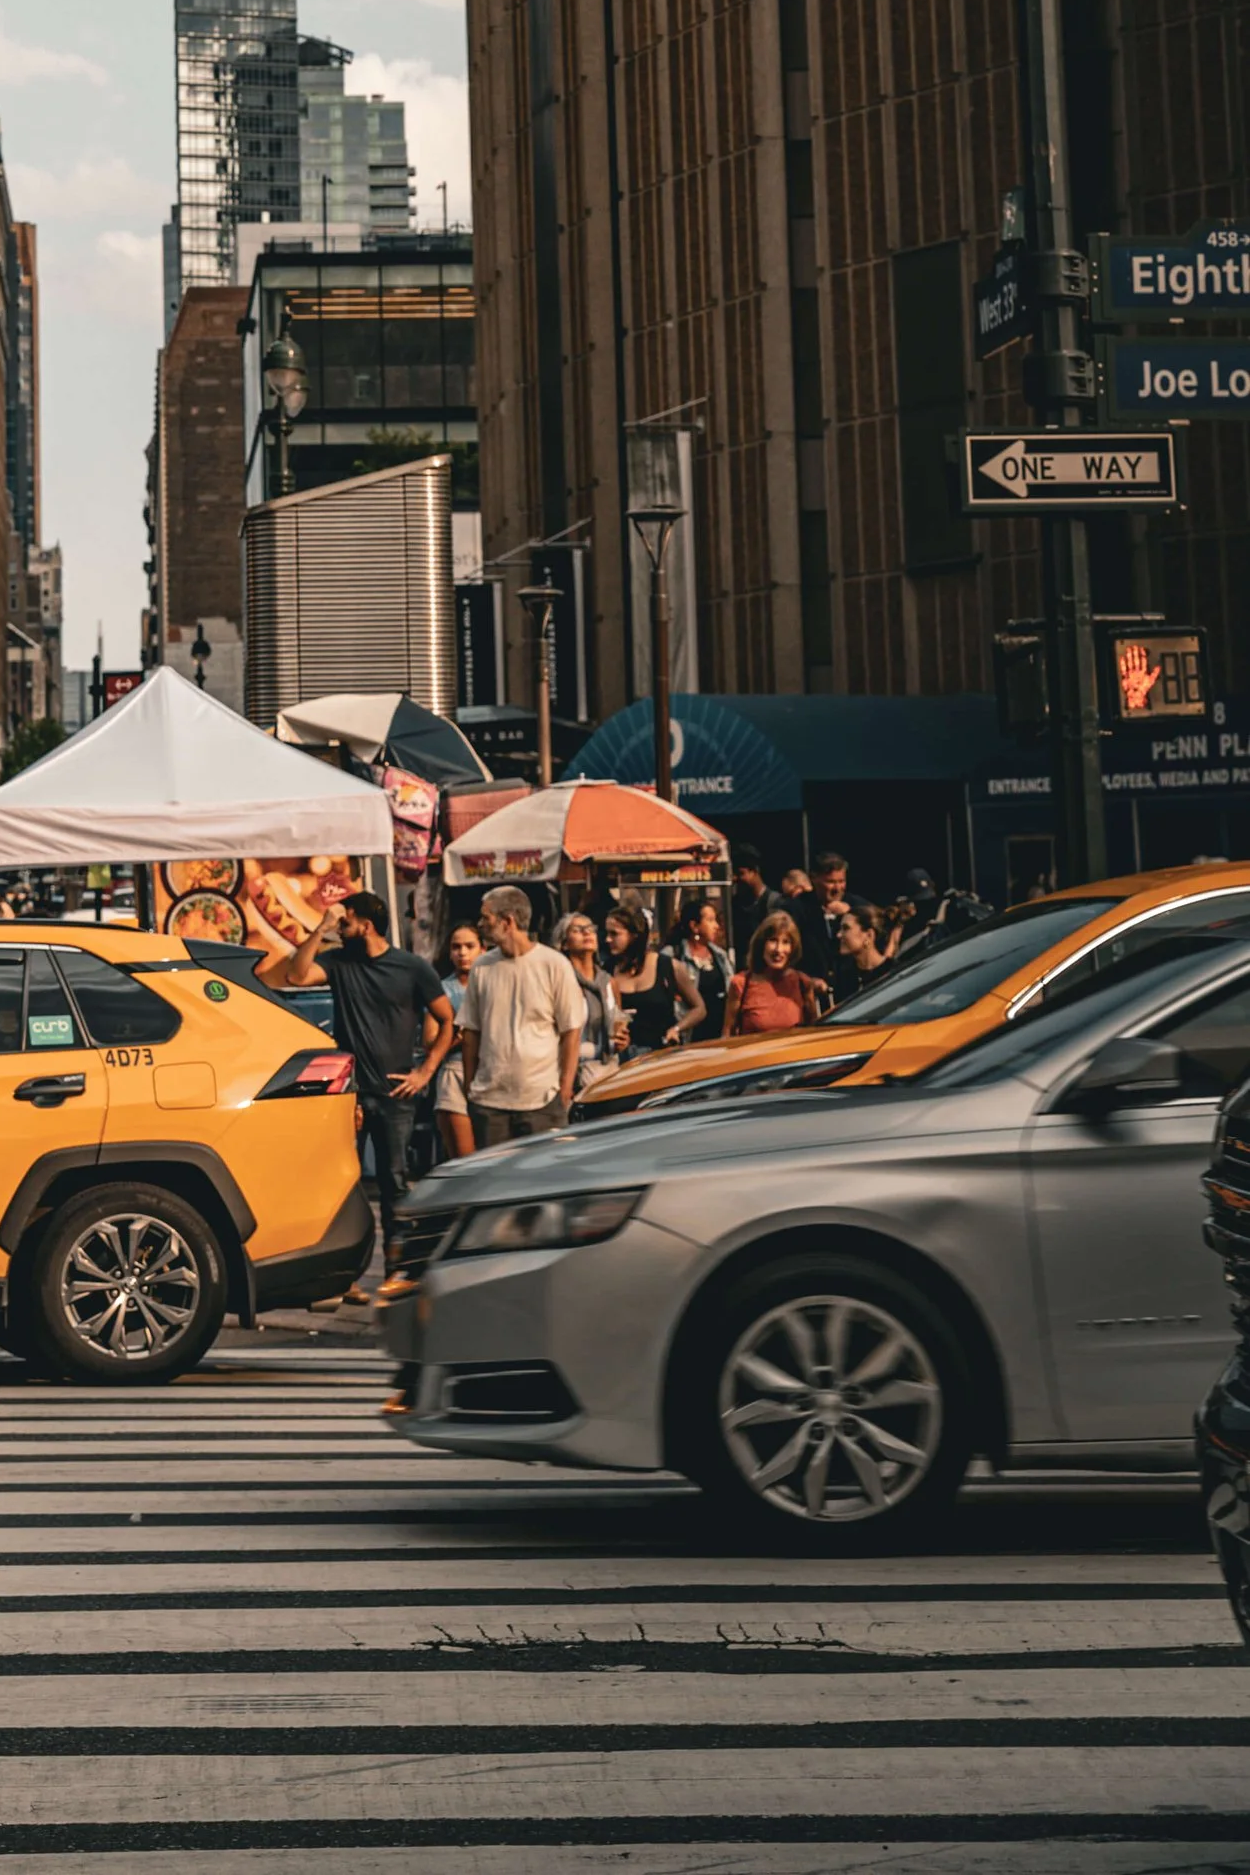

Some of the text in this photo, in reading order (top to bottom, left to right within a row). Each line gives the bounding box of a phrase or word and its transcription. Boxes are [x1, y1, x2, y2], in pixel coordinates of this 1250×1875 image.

[1206, 231, 1239, 247] 458
[978, 292, 1002, 334] West
[1137, 360, 1198, 398] Joe
[1002, 456, 1142, 481] ONE WAY
[1213, 700, 1227, 725] 8
[1151, 734, 1208, 761] PENN
[987, 777, 1052, 795] ENTRANCE
[1202, 768, 1230, 785] AND
[32, 1020, 69, 1033] curb
[105, 1049, 154, 1067] 4D73
